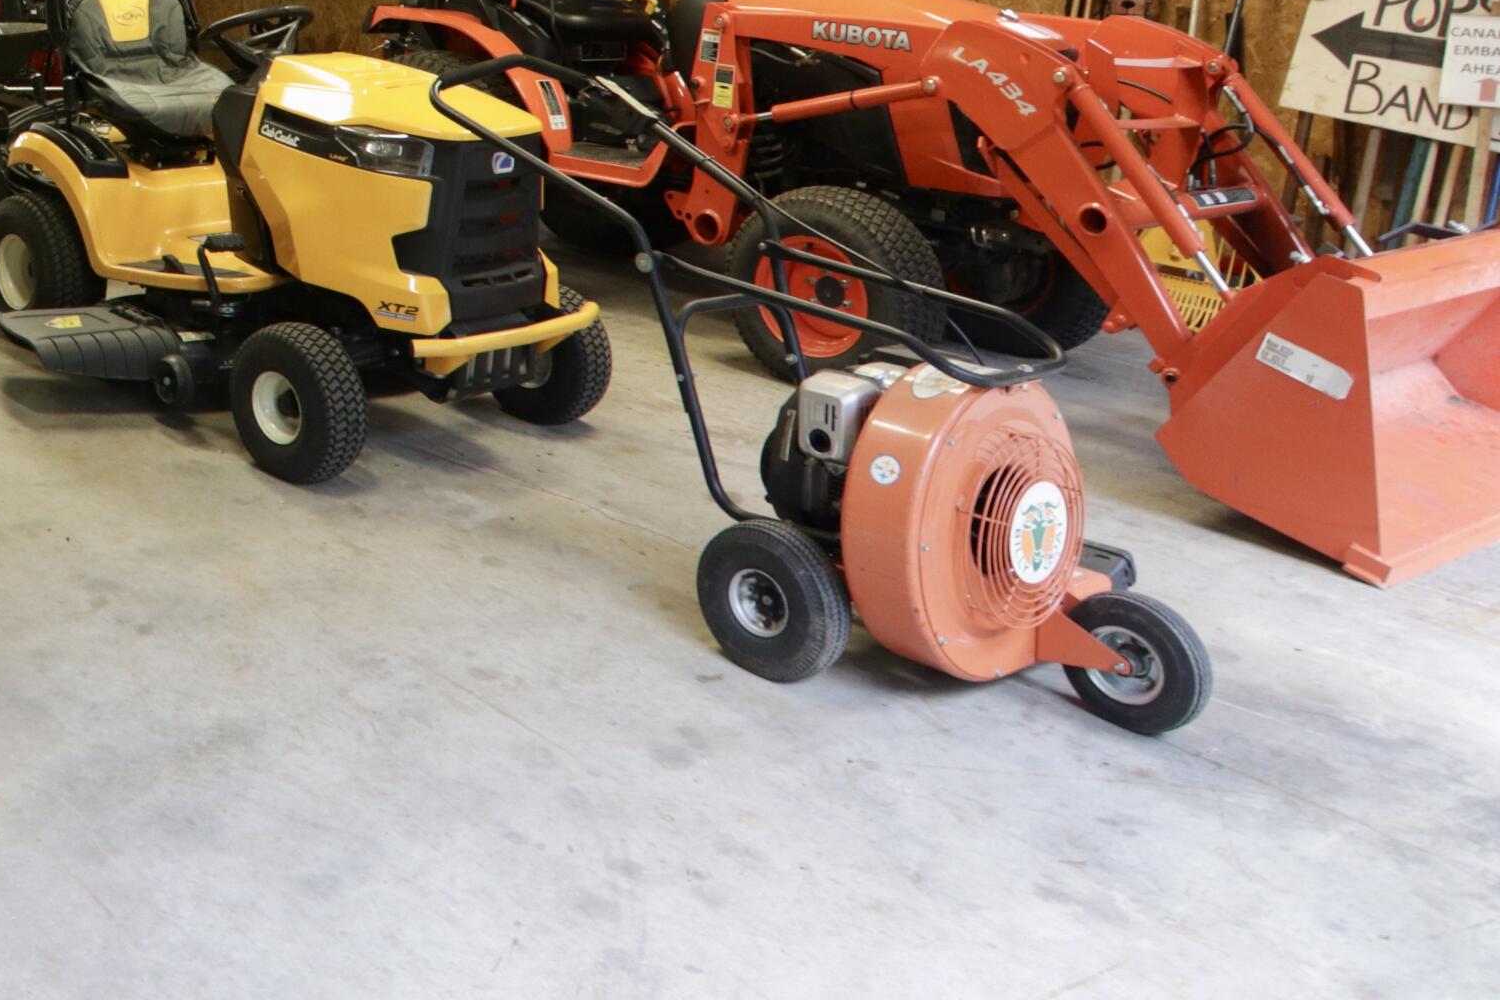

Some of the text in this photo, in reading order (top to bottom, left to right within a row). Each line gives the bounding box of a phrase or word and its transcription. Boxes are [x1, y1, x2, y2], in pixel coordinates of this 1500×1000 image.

[811, 19, 913, 52] KUBOTA
[1450, 26, 1500, 40] CANA
[951, 46, 1037, 117] LA434
[377, 300, 420, 316] XT2
